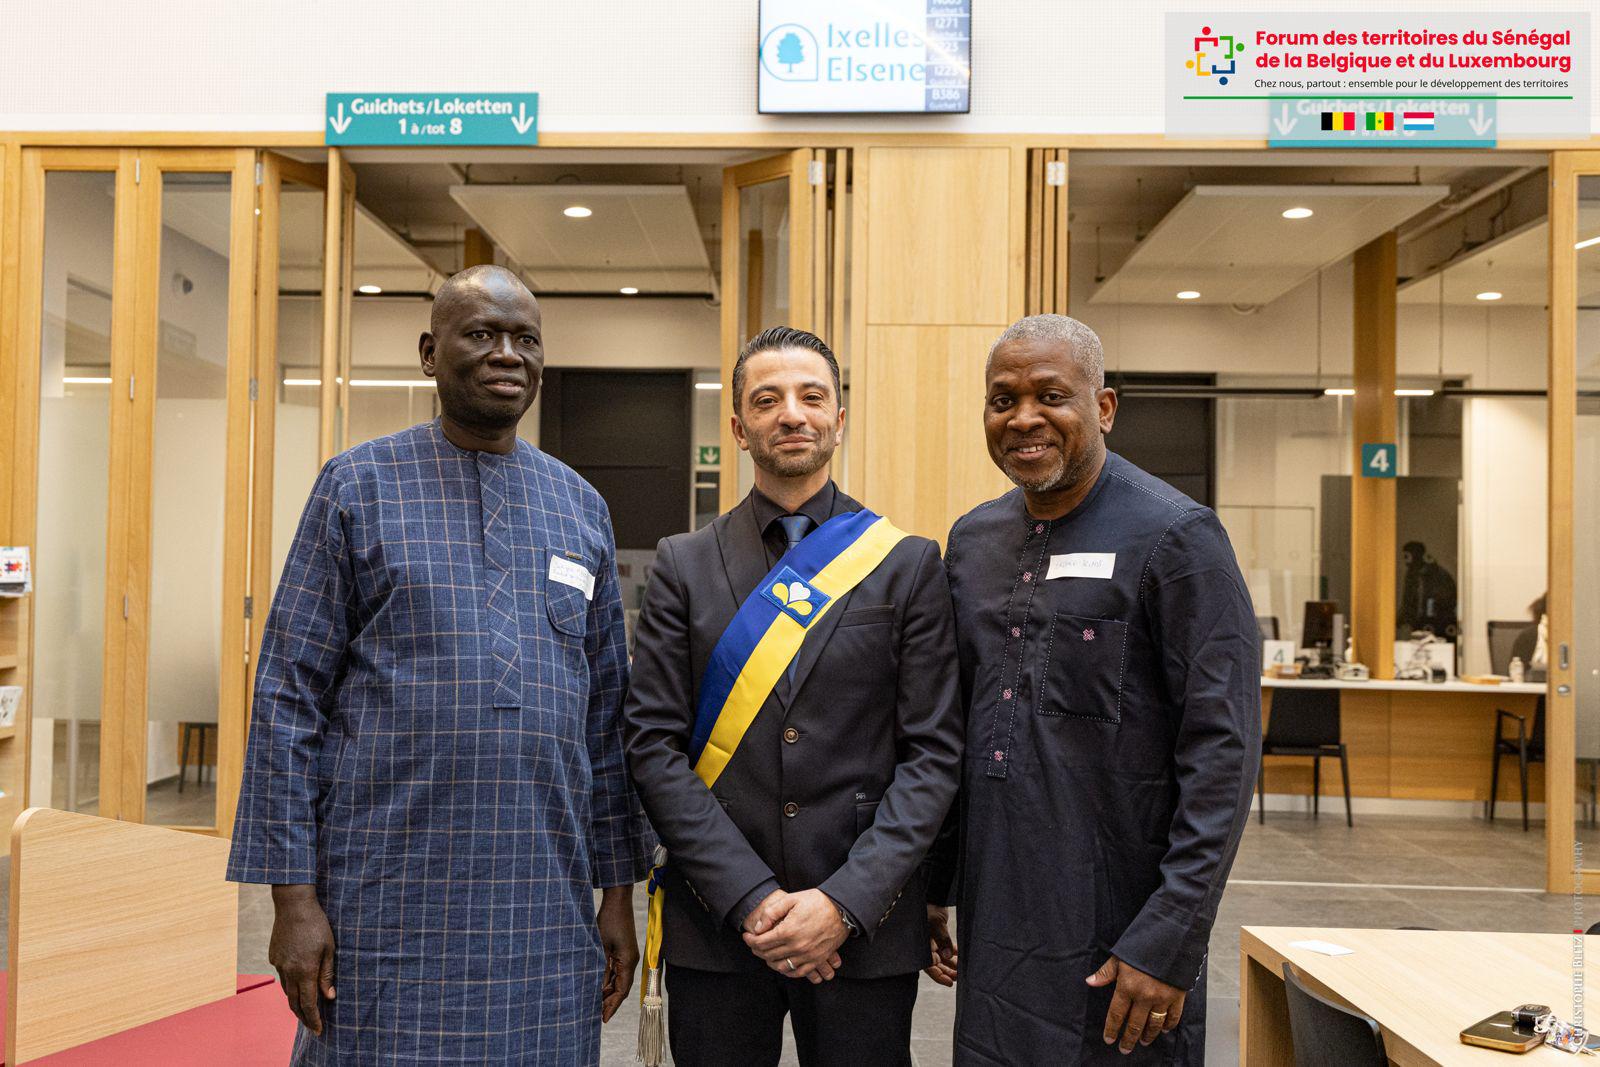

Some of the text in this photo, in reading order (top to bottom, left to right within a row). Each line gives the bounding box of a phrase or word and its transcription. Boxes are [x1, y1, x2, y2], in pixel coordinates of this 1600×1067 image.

[828, 23, 923, 48] Ixelles
[828, 56, 925, 81] Elsene
[399, 118, 407, 135] 1
[450, 118, 463, 135] 8
[1370, 449, 1390, 472] 4
